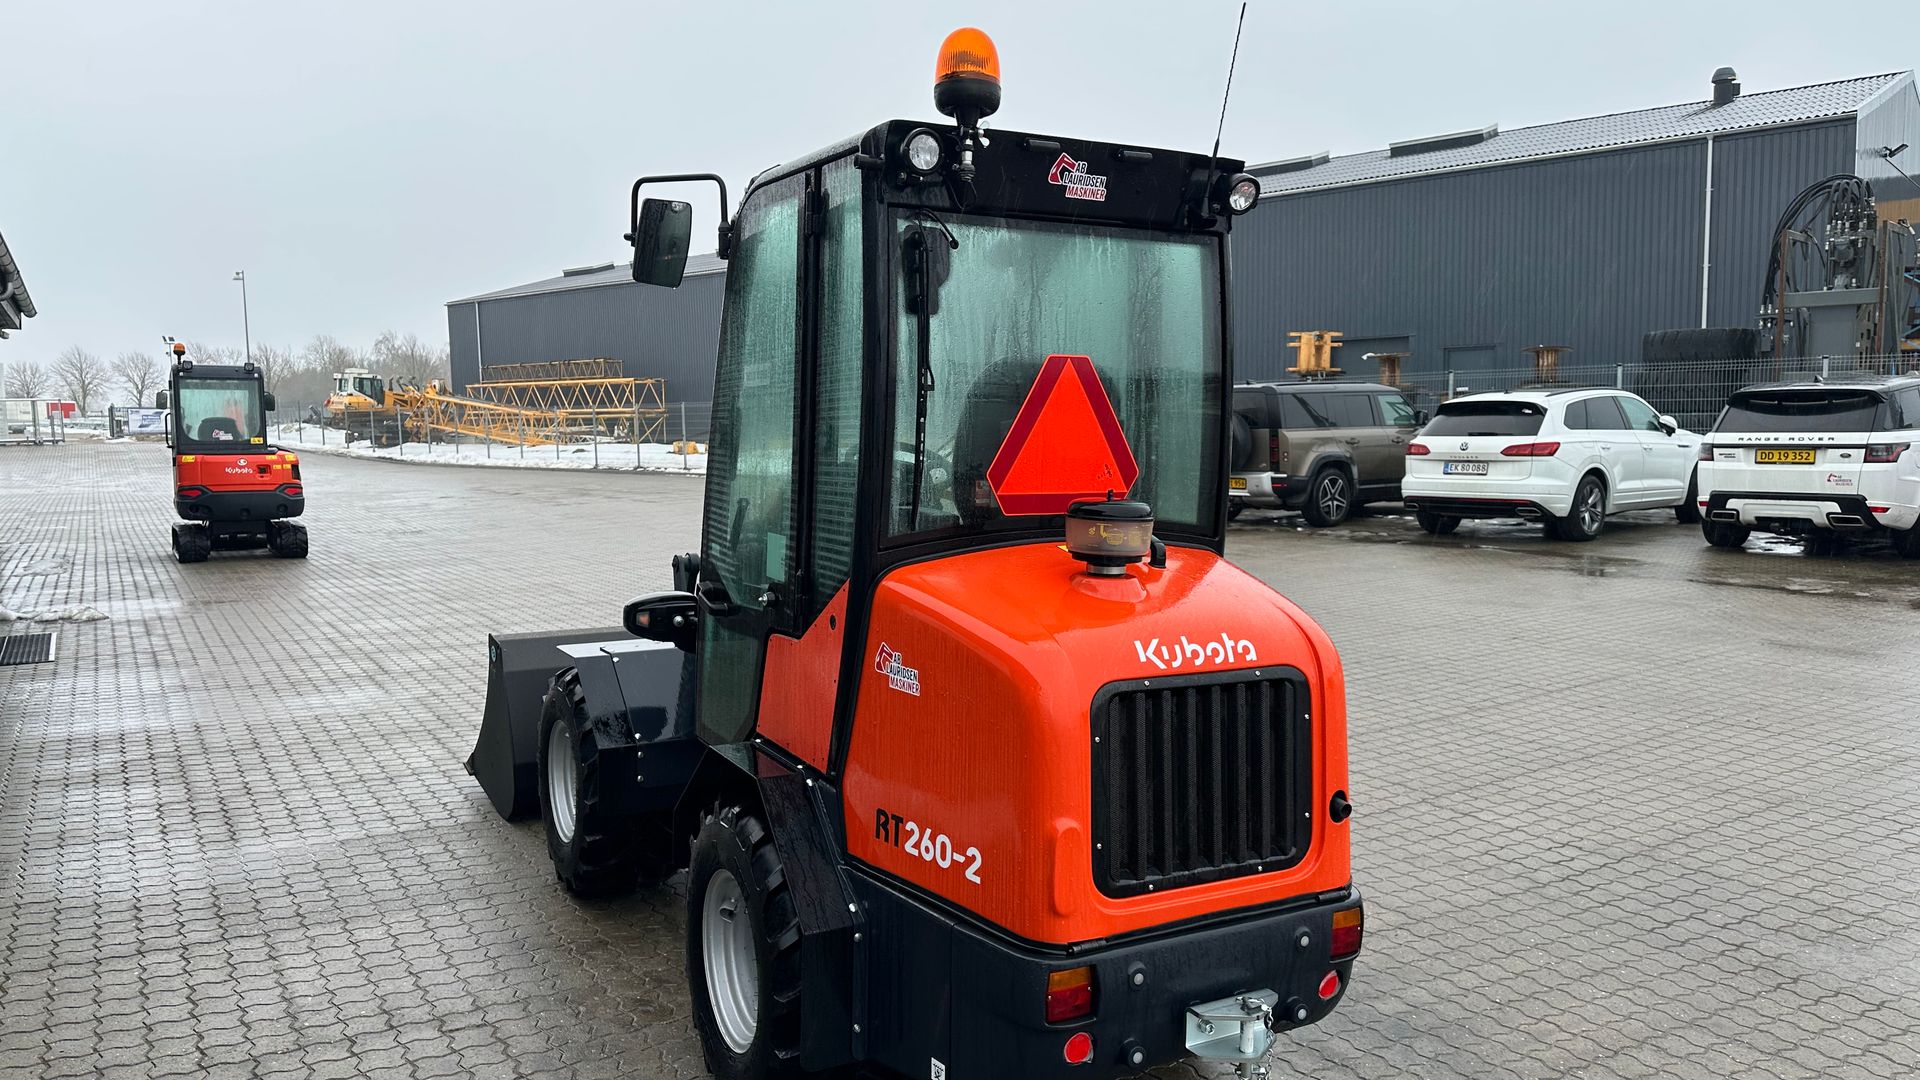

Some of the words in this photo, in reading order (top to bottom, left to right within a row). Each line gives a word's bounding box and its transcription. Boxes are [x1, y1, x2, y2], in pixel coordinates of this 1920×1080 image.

[1075, 161, 1087, 174] AB
[1063, 172, 1107, 188] LAURIDSEN
[1066, 185, 1107, 200] MASKINER
[1760, 452, 1775, 461] DD
[1778, 452, 1788, 461] 19
[1791, 452, 1811, 461] 352
[1449, 463, 1460, 472] EK
[1133, 632, 1258, 669] Kubota
[893, 653, 902, 665] AB
[885, 662, 918, 682] LAURIDSEN
[889, 676, 920, 694] MASKINER
[875, 808, 982, 885] RT260-2
